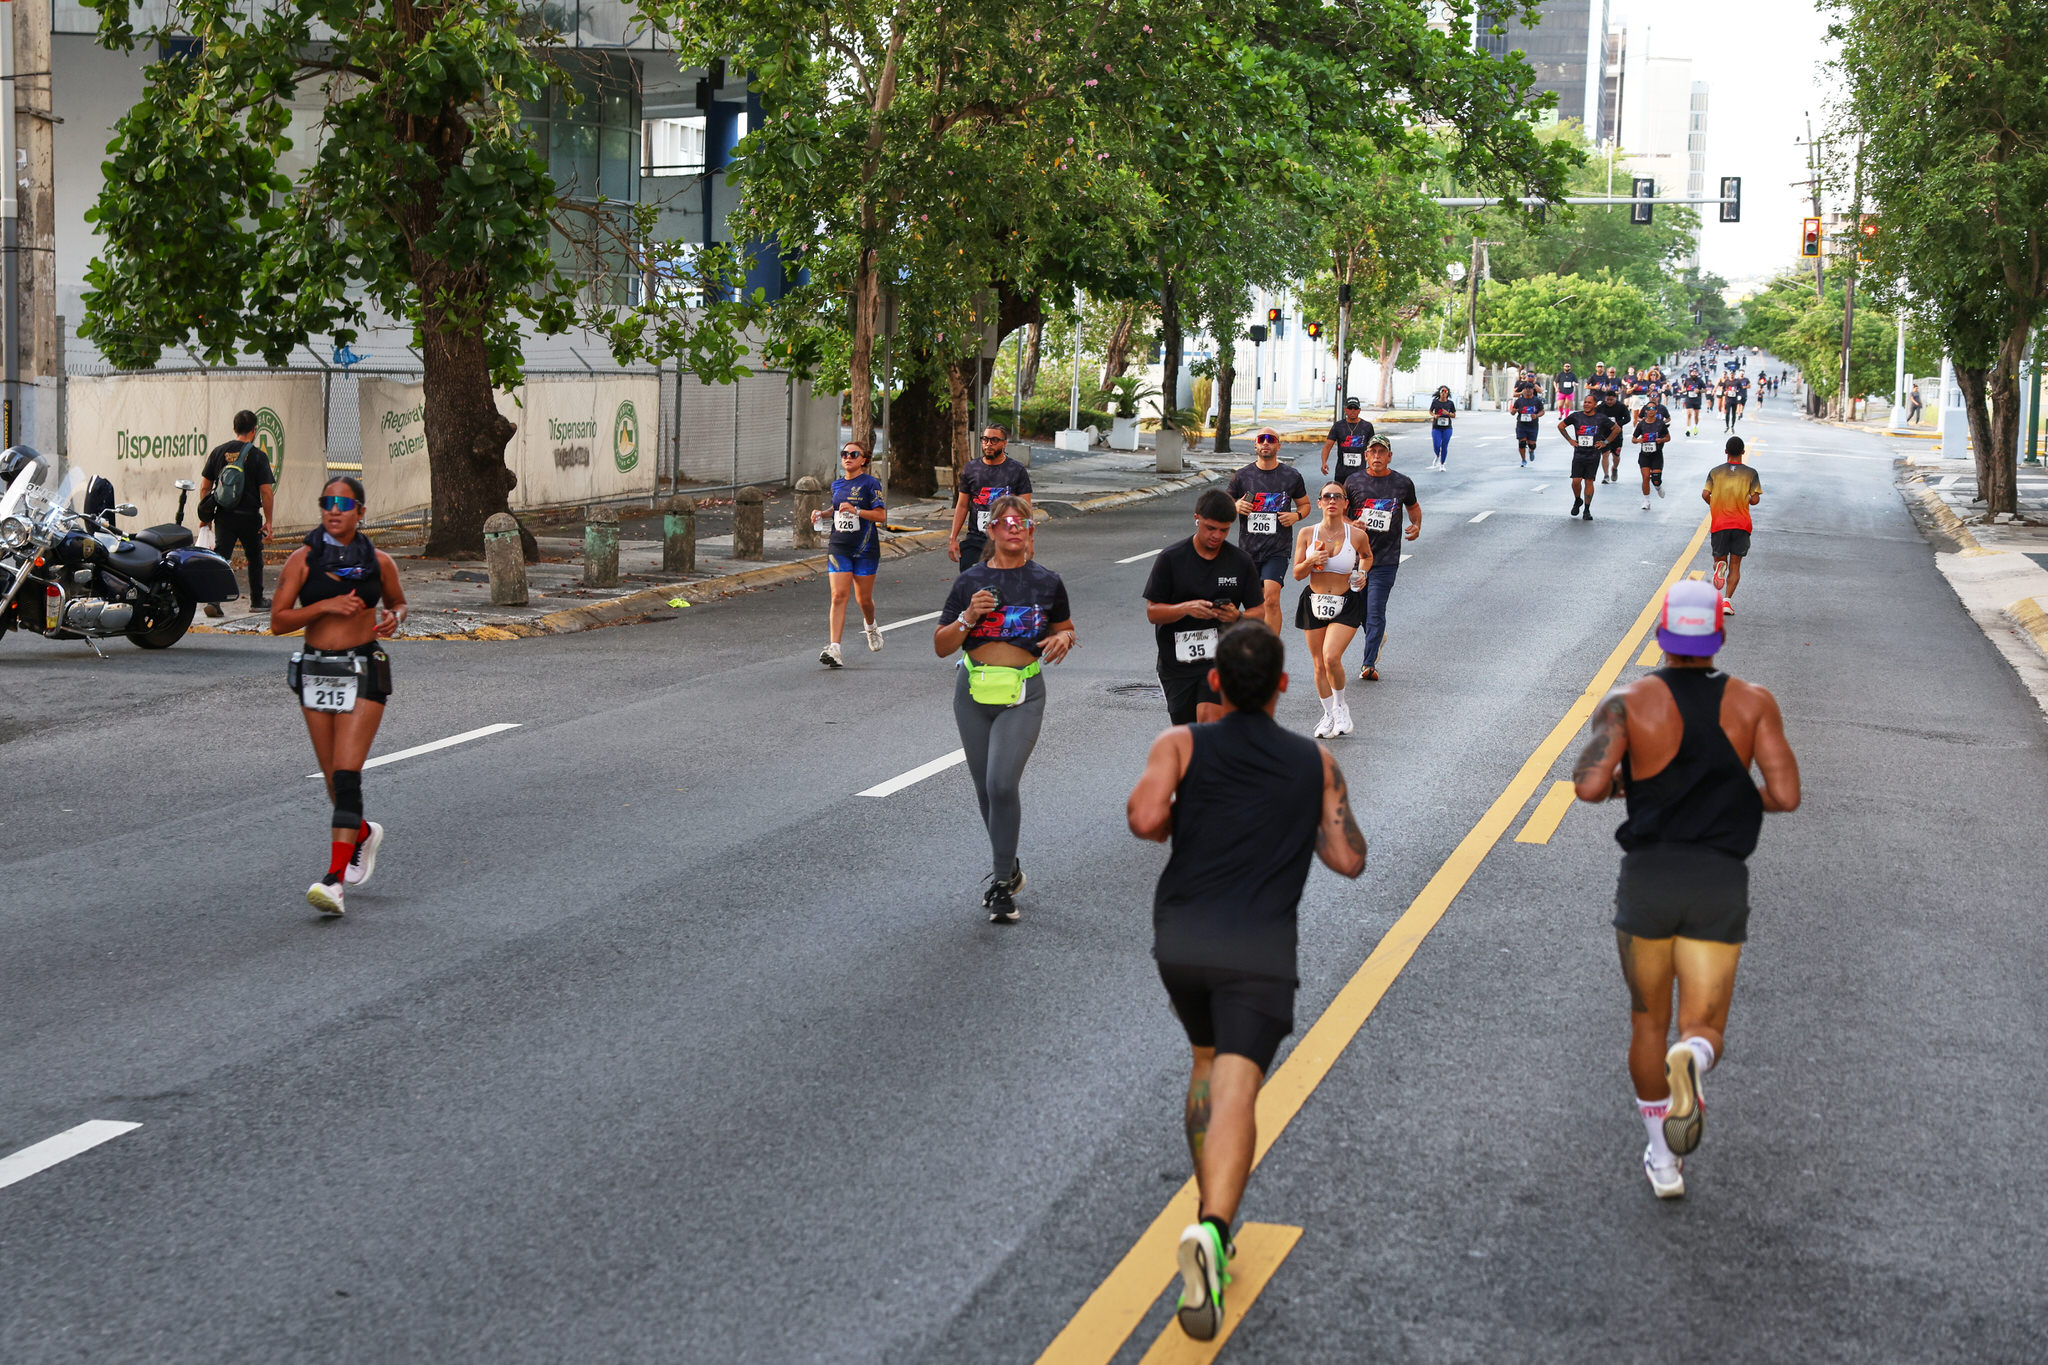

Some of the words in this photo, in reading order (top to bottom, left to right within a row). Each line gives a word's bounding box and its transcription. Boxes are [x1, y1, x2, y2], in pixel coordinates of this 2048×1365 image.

[548, 416, 598, 446] Dispensario
[117, 426, 208, 467] Dispensario
[1252, 492, 1281, 507] 5K
[1252, 522, 1270, 532] 206
[1366, 518, 1385, 529] 205
[1317, 605, 1336, 617] 136
[1188, 644, 1206, 657] 35
[315, 690, 345, 706] 215
